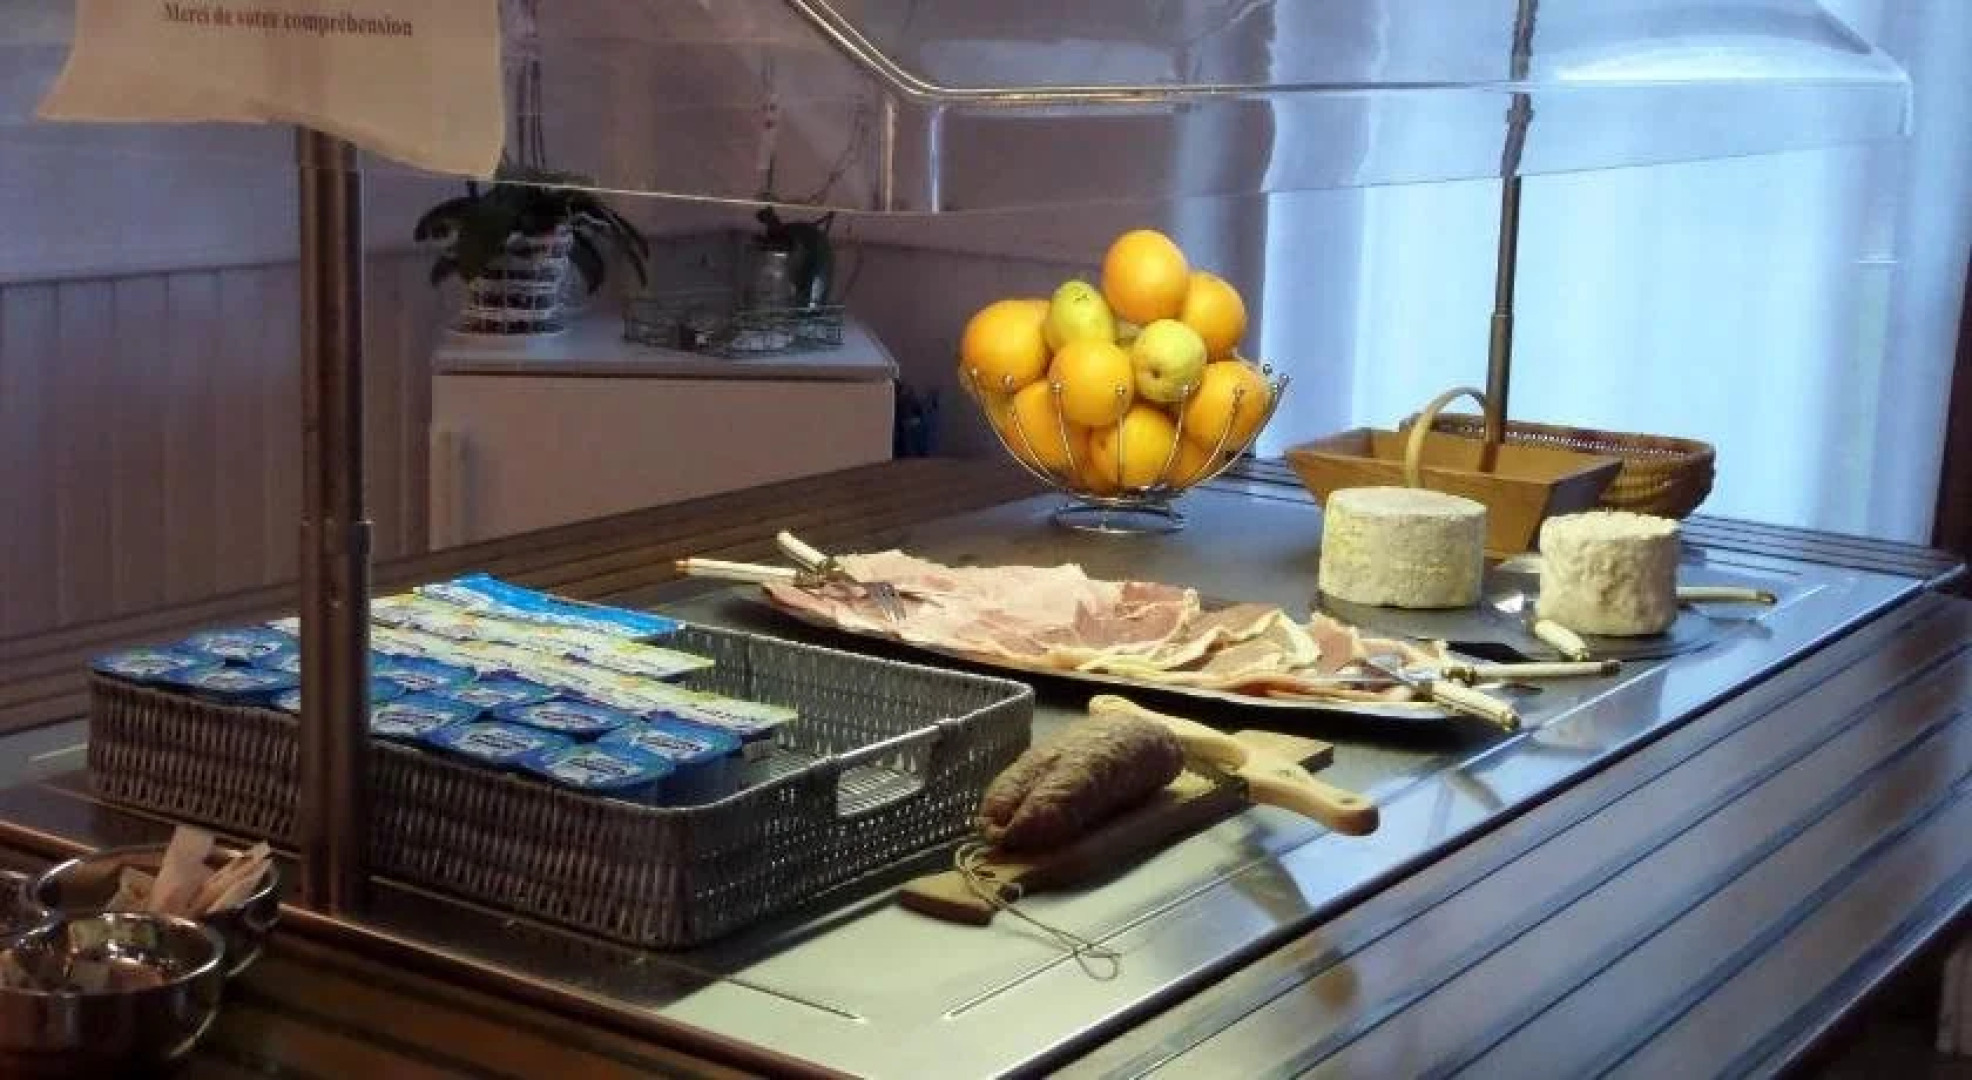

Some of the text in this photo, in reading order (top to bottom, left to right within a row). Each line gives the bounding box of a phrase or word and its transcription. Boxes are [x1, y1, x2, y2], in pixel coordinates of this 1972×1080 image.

[164, 2, 412, 37] Merci de votre compréhension
